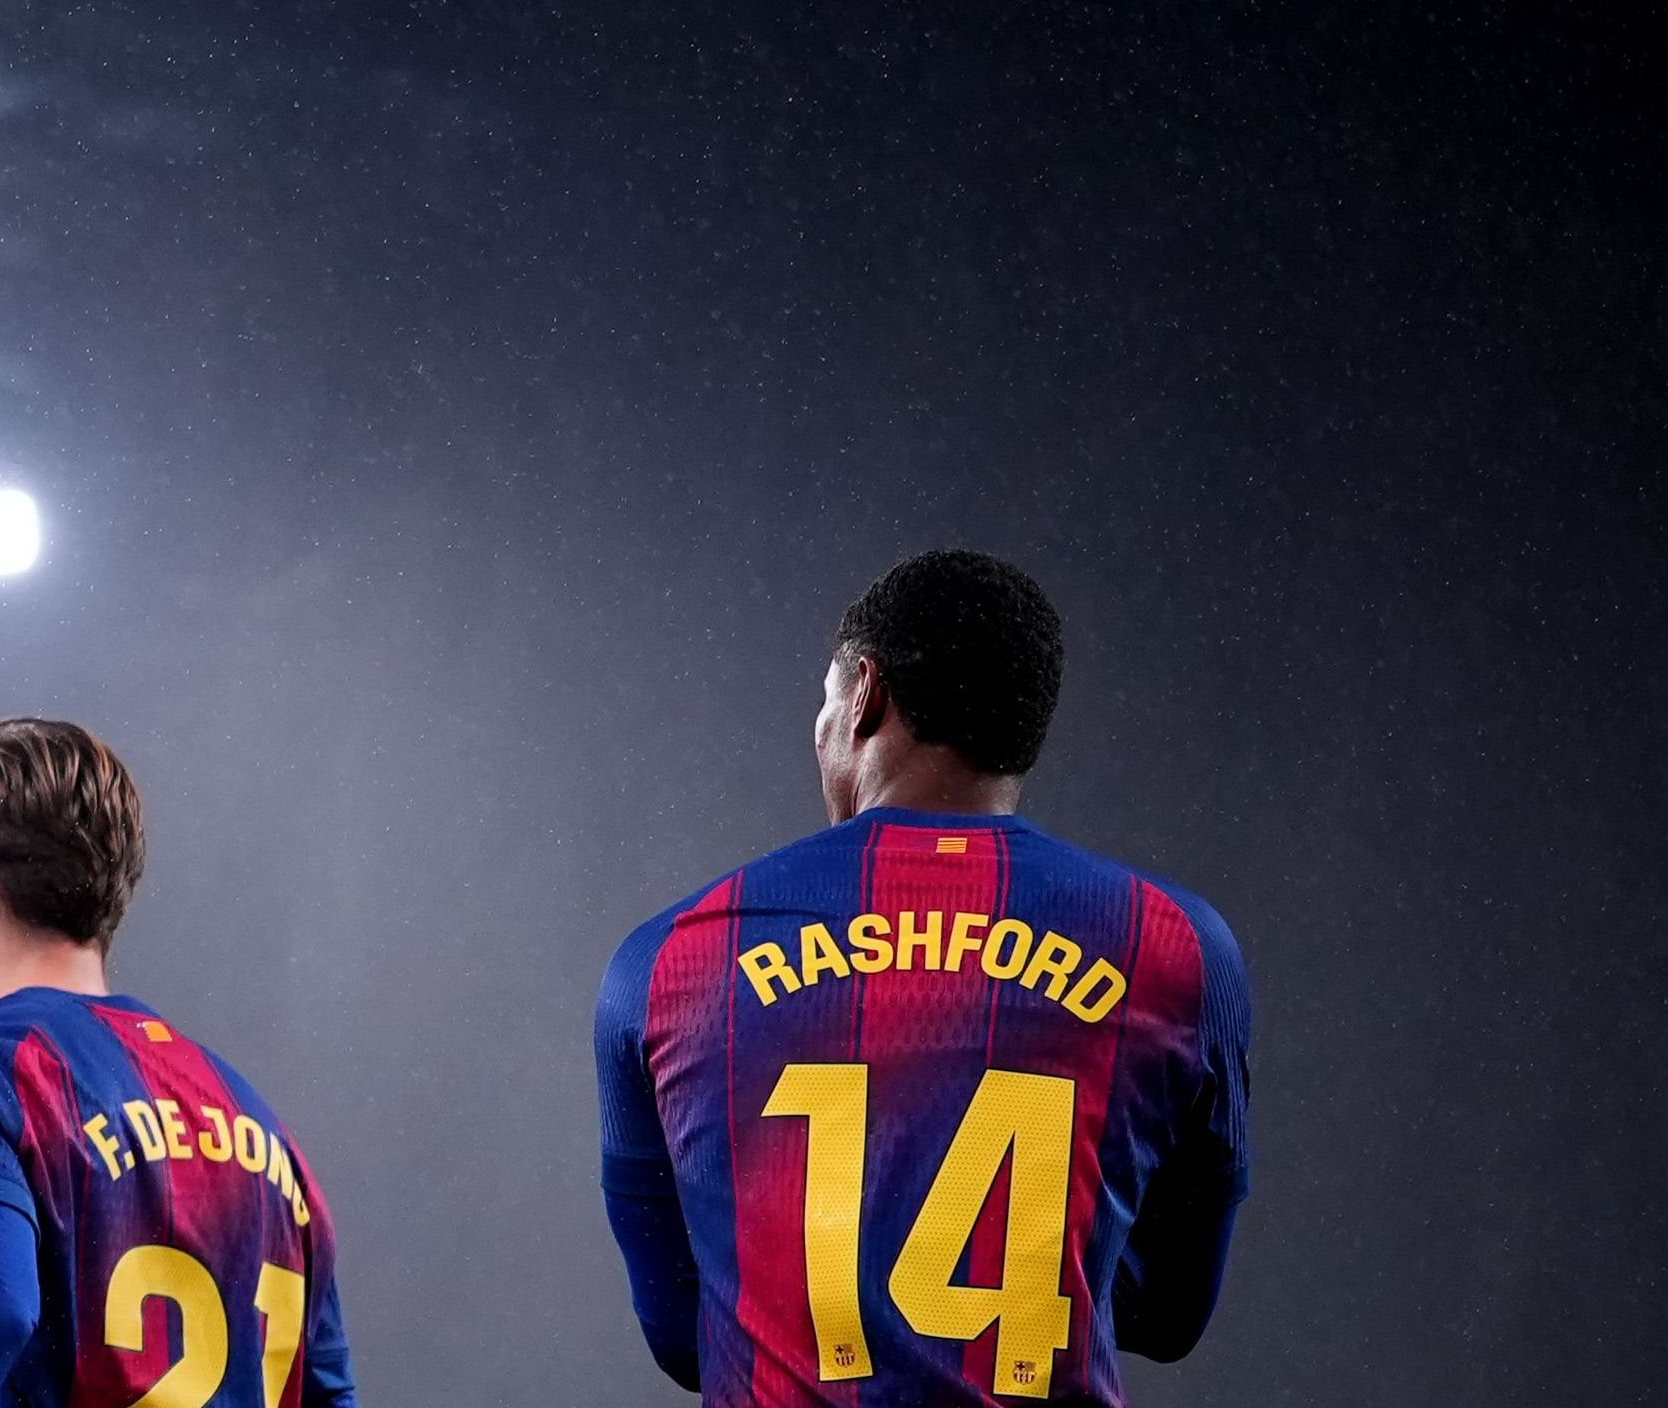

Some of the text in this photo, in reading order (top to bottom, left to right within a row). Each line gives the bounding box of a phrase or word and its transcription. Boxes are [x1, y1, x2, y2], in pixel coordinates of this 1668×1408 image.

[737, 910, 1127, 1024] RASHFORD
[83, 1112, 136, 1182] F.
[123, 1098, 194, 1162] DE
[760, 1062, 1076, 1398] 14
